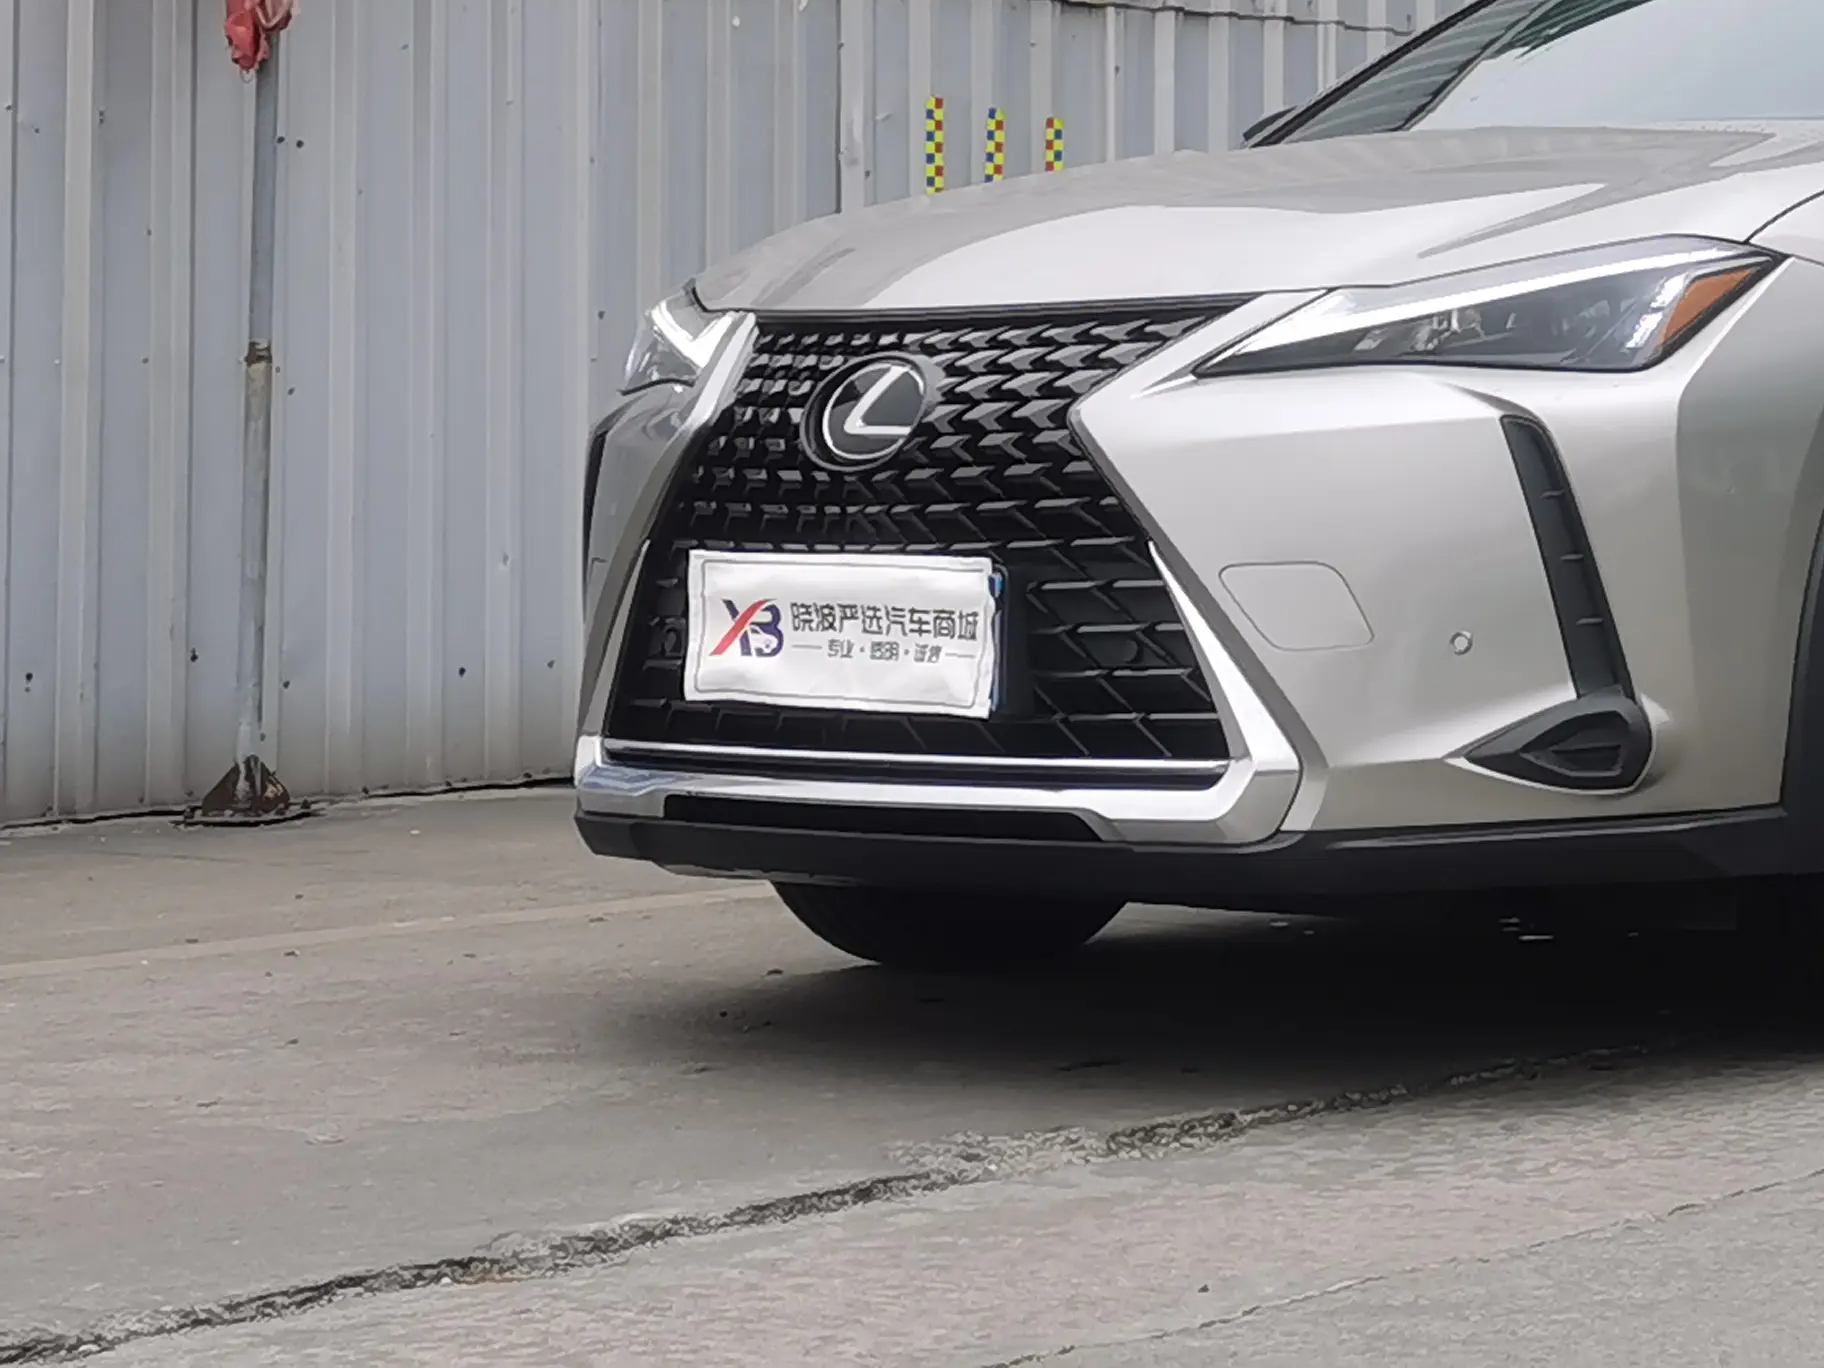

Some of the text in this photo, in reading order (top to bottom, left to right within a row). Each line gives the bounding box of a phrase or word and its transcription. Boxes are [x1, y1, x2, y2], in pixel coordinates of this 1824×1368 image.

[789, 601, 980, 642] 晓波严选汽车商城
